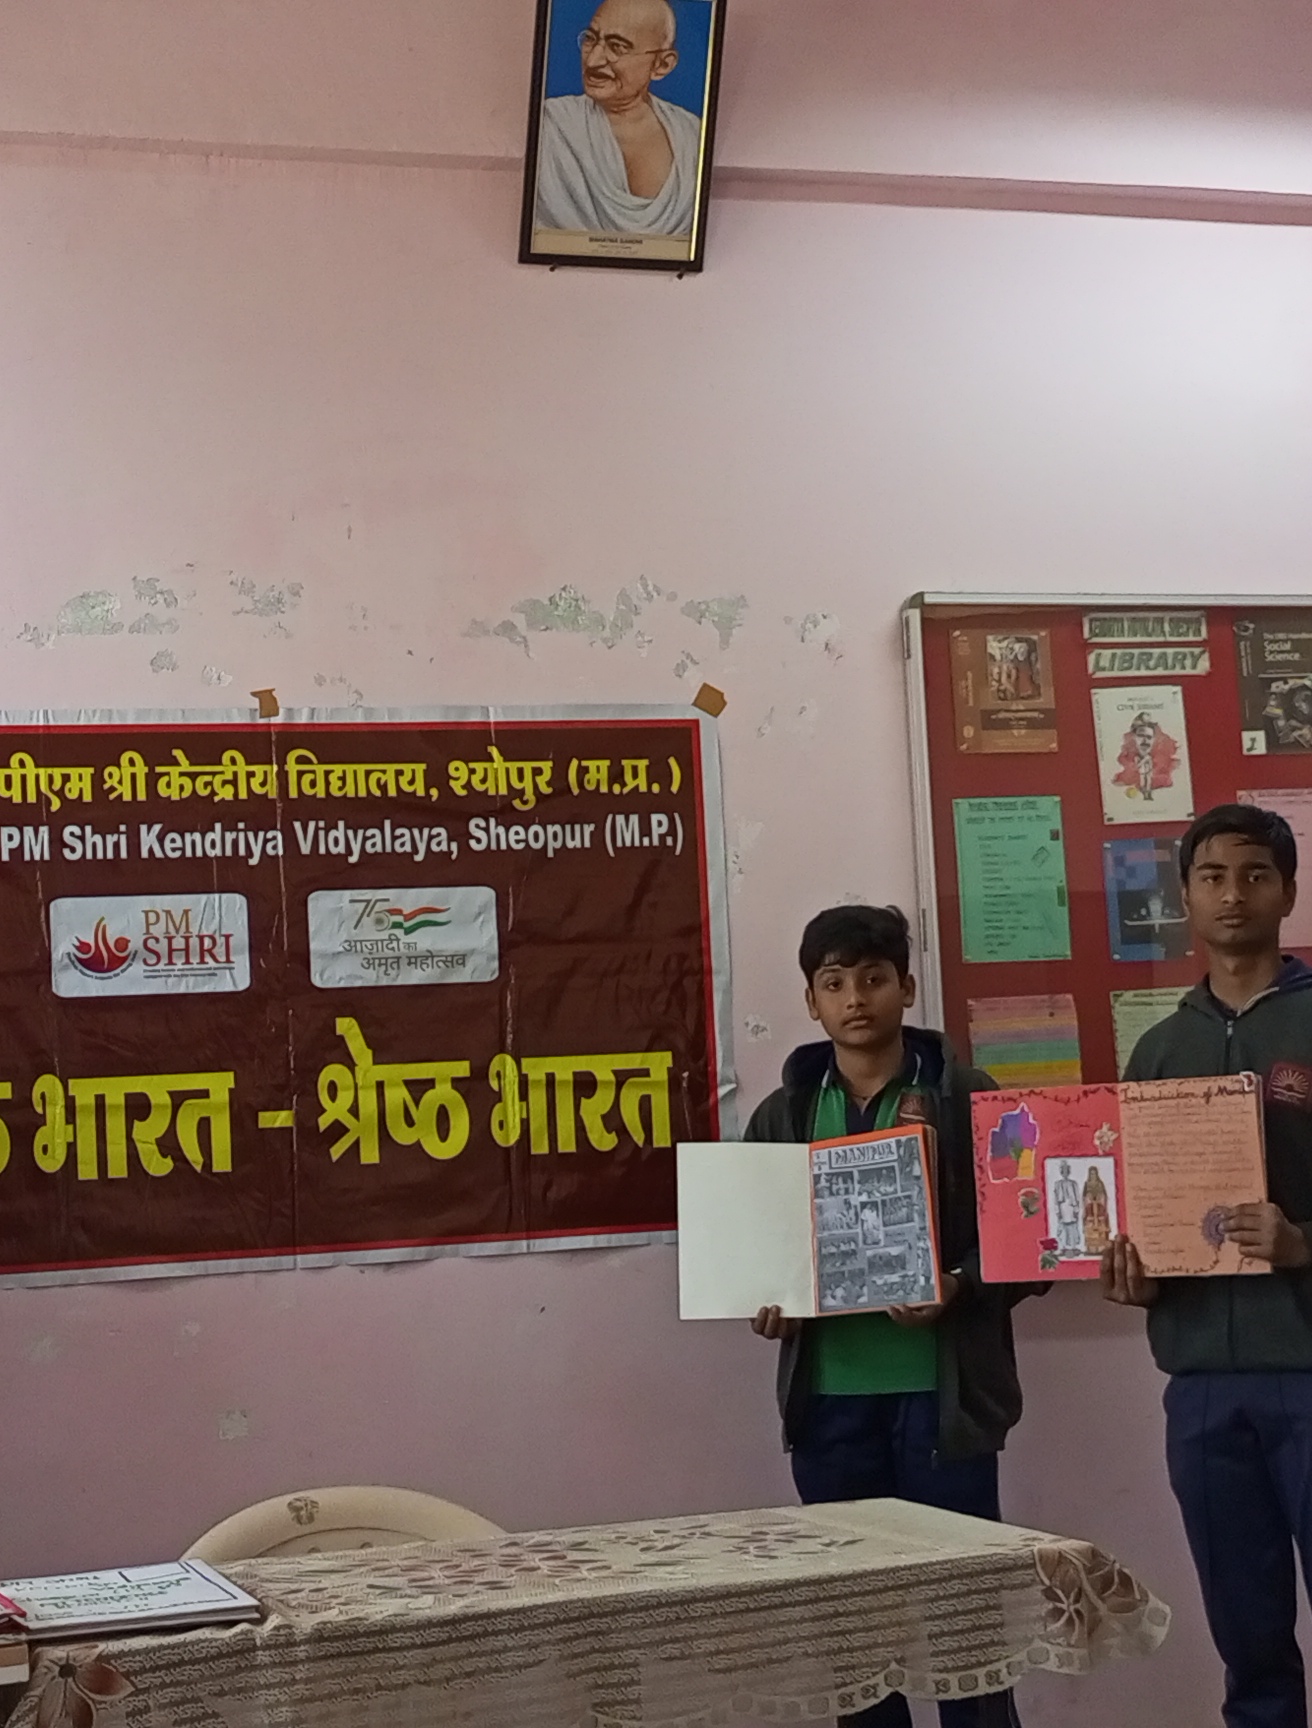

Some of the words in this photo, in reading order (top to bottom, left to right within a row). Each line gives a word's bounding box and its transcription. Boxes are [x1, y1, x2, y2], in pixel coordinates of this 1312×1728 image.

[1263, 640, 1291, 652] Social
[1264, 651, 1301, 662] Science
[1092, 649, 1207, 672] LIBRARY
[103, 750, 149, 802] श्री
[155, 748, 278, 803] केन्द्रीय
[284, 748, 439, 802] विद्यालय,
[448, 745, 554, 812] श्योपुर
[0, 825, 50, 862] PM
[62, 823, 128, 860] Shri
[140, 821, 284, 866] Kendriya
[293, 818, 458, 864] Vidyalaya,
[468, 815, 595, 858] Sheopur
[605, 812, 684, 858] (M.P.)
[142, 908, 193, 936] PM
[142, 933, 235, 967] SHRI
[402, 940, 418, 952] का
[360, 955, 403, 976] अमृत
[406, 949, 468, 972] महोत्सव
[32, 1070, 236, 1182] भारत
[316, 1016, 471, 1165] श्रेष्ठ
[488, 1050, 674, 1156] भारत
